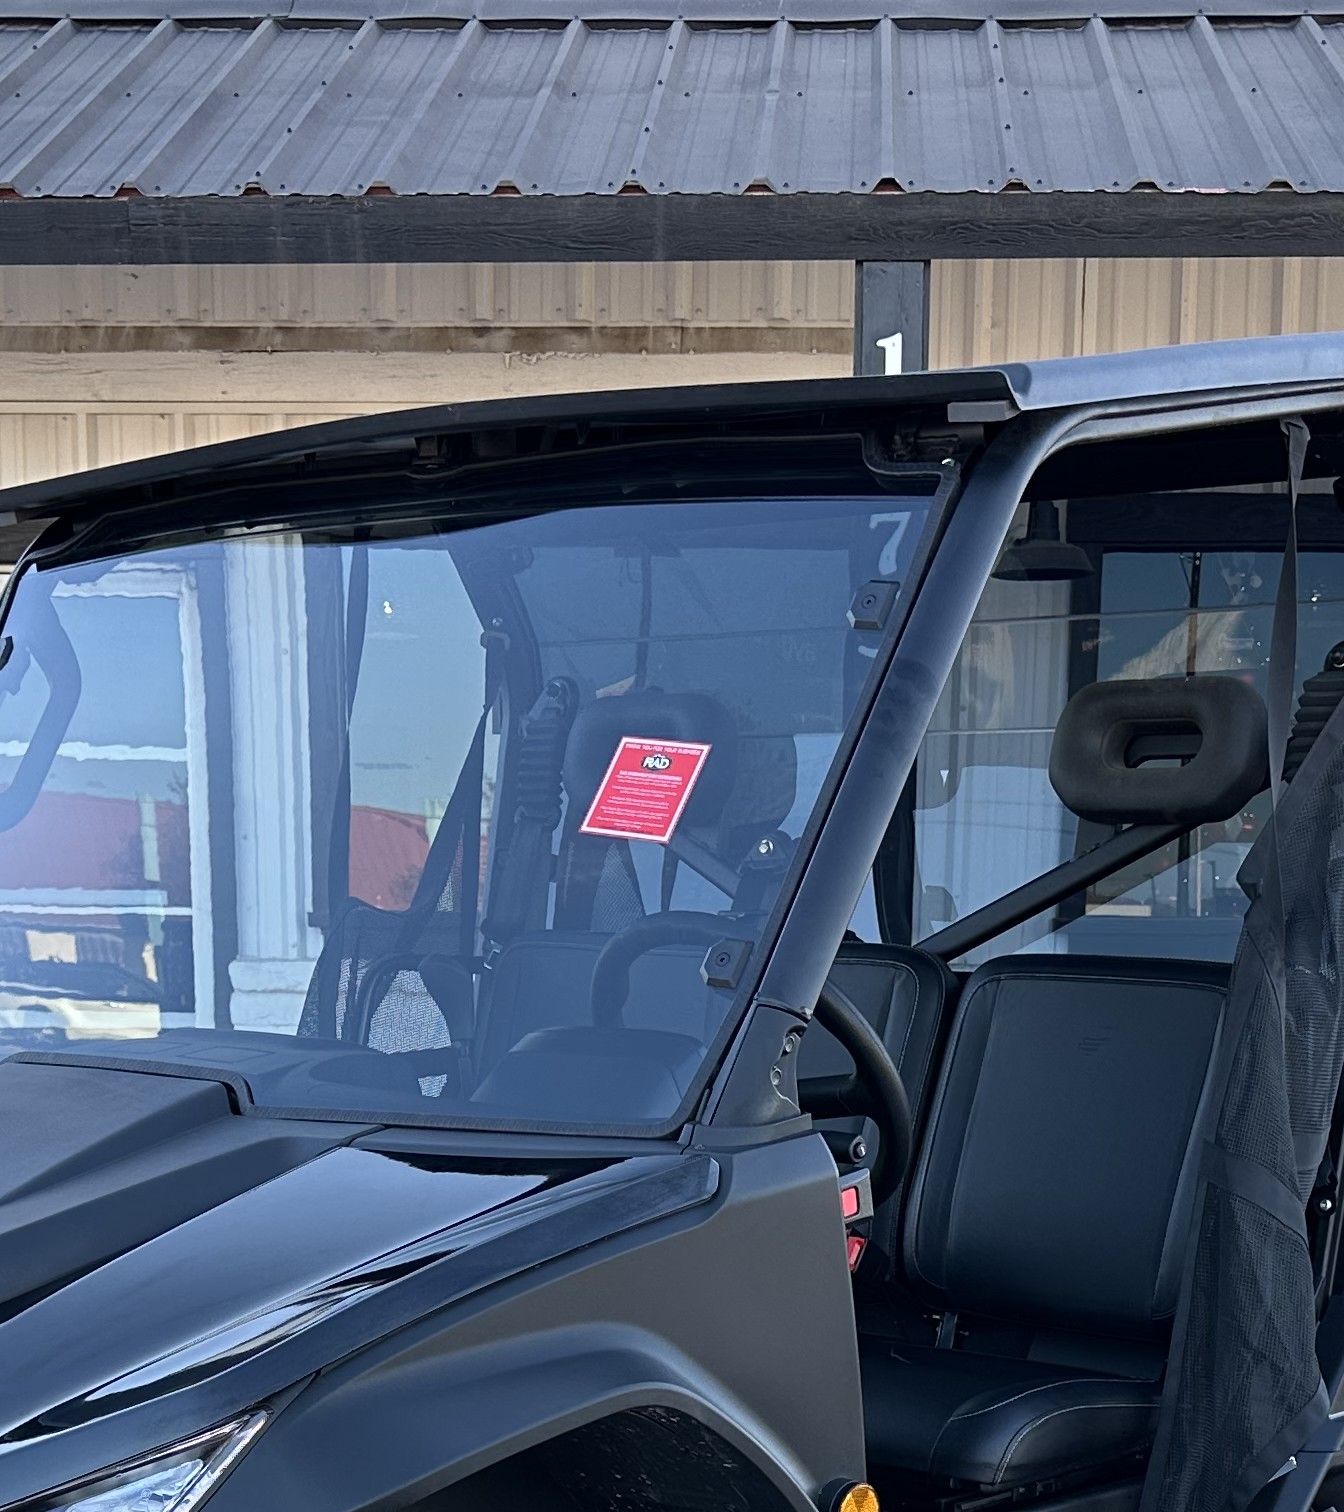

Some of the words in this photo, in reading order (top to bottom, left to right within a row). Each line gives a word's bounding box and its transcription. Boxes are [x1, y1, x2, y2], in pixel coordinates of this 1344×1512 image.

[875, 332, 902, 375] 1
[869, 512, 911, 575] 7
[643, 756, 670, 769] RAD
